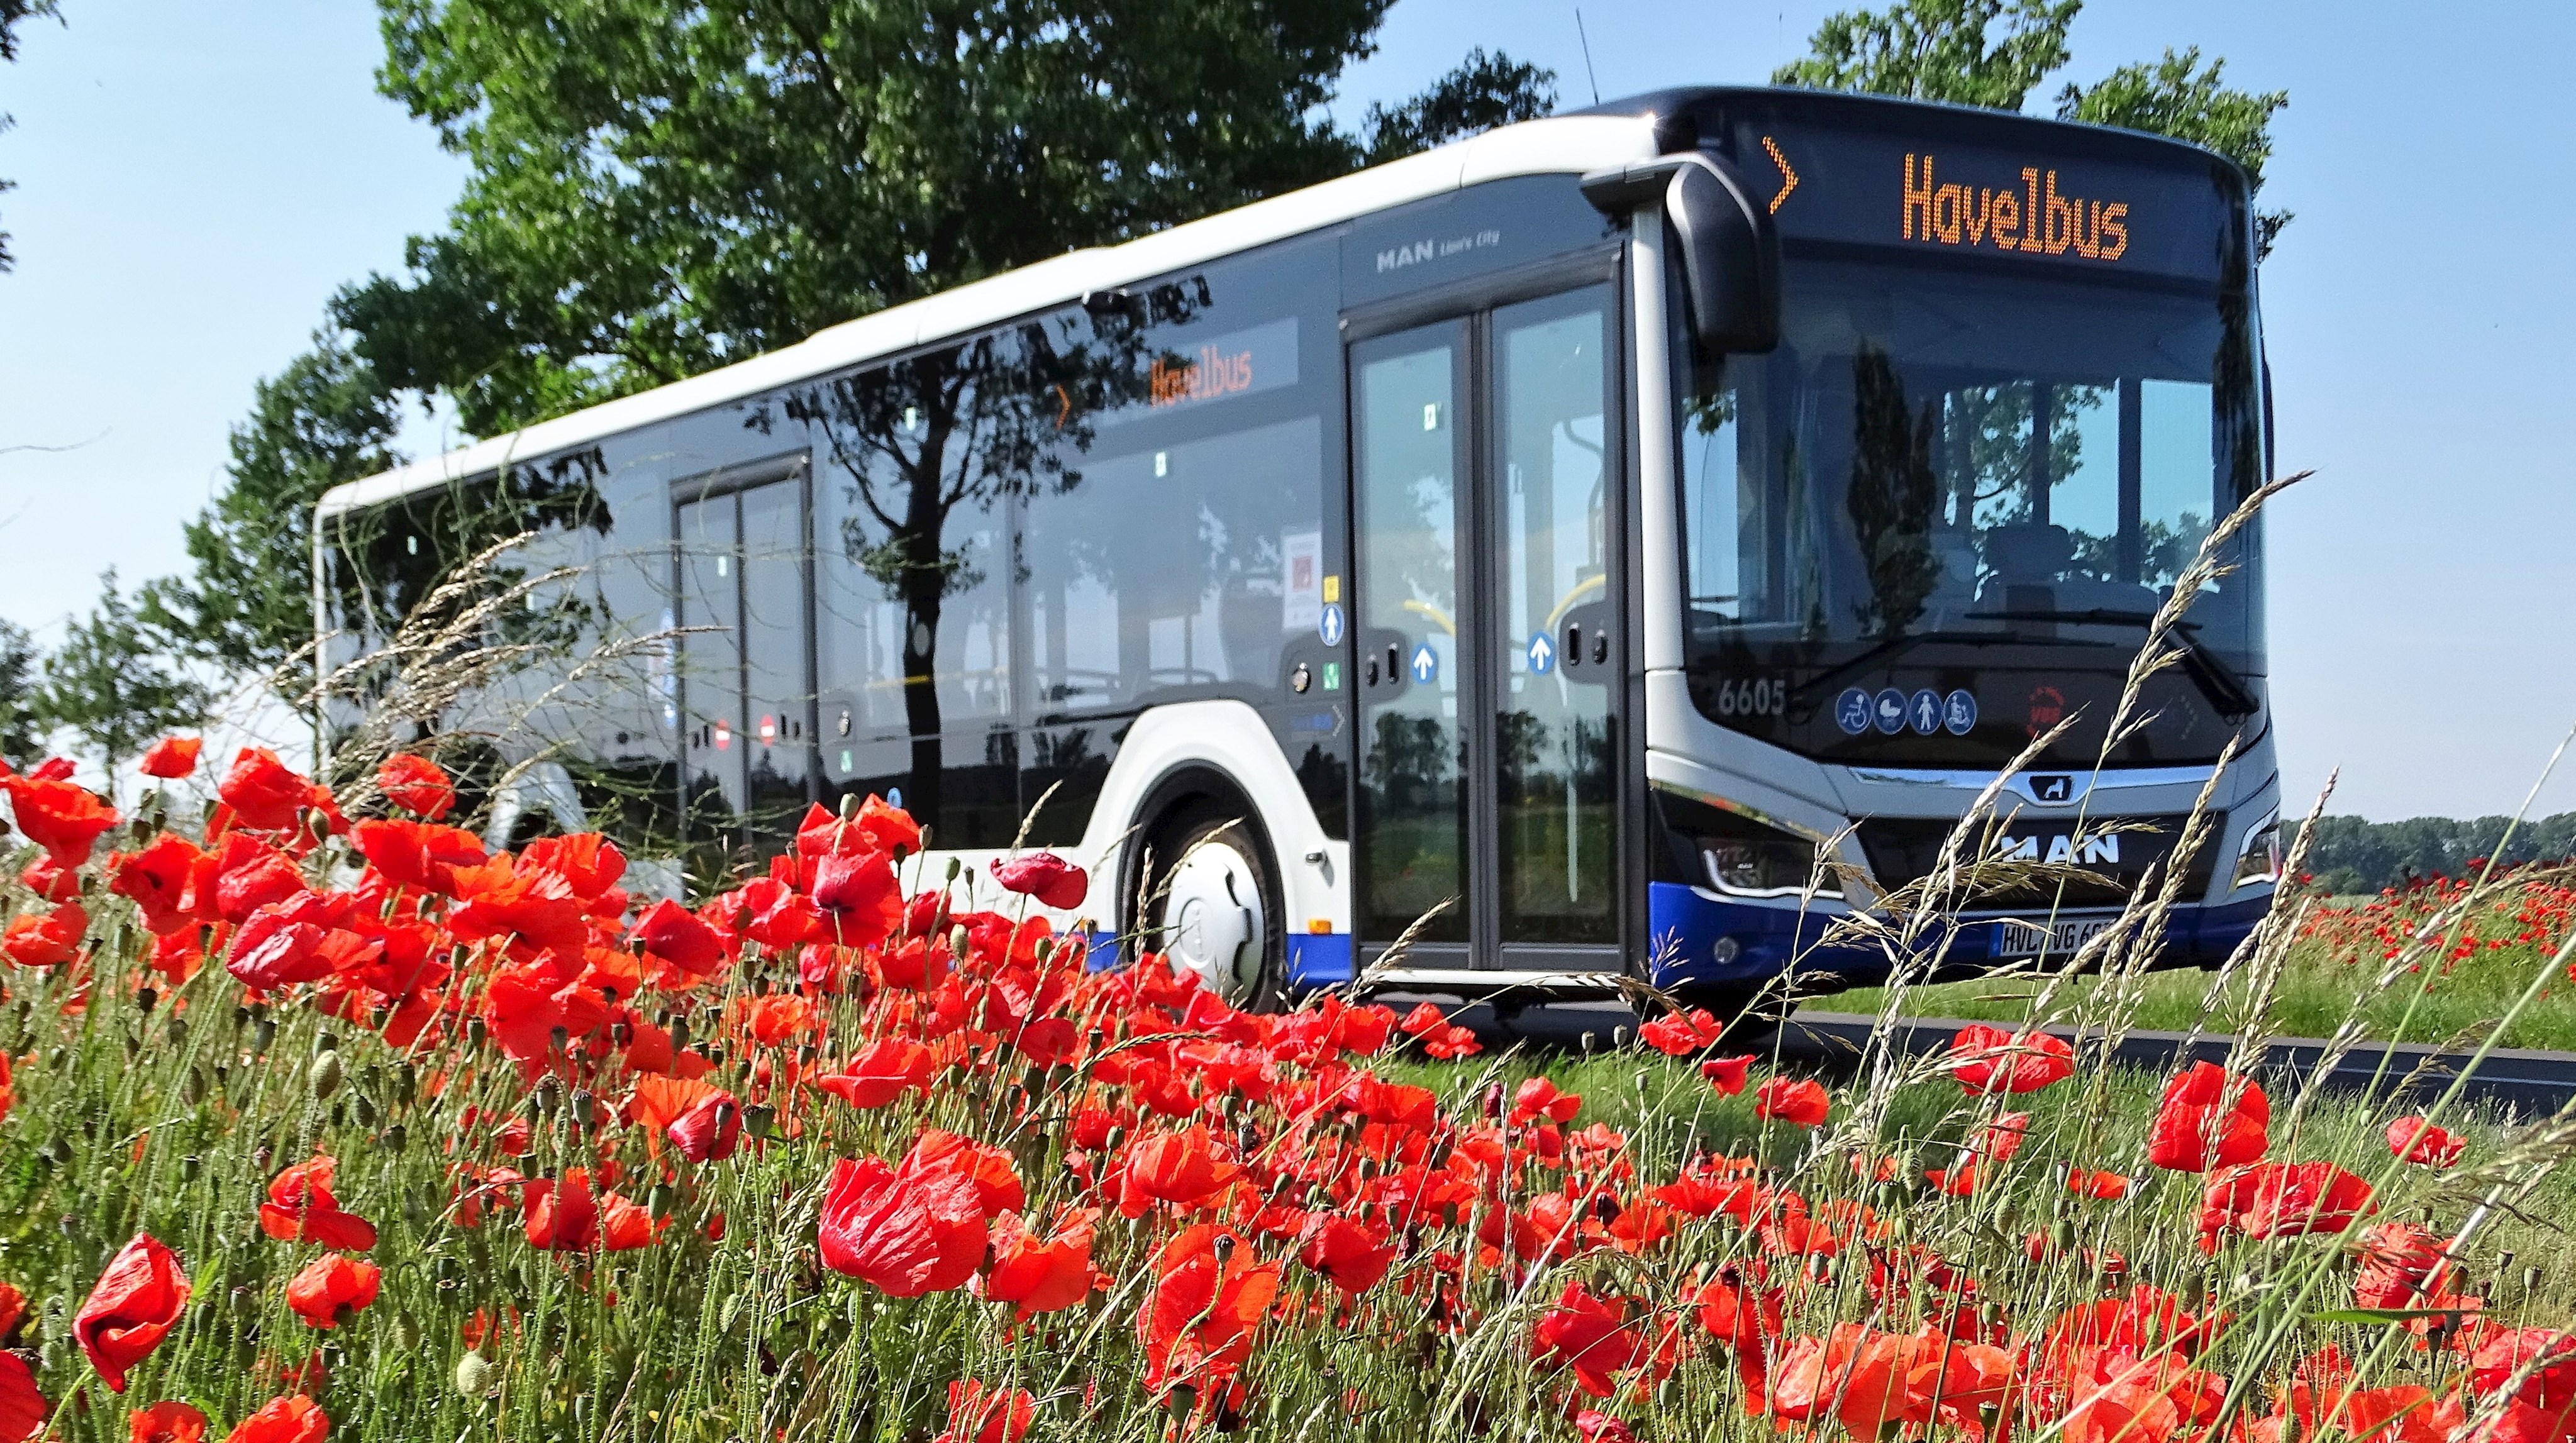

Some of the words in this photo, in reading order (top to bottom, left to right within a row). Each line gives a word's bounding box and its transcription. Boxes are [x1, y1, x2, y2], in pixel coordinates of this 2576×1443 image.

[1903, 153, 2128, 260] Havelbus
[1377, 238, 1433, 272] MAN
[1150, 345, 1252, 409] Havelbus
[1719, 678, 1785, 715] 6605
[2001, 834, 2119, 864] MAN
[2003, 924, 2037, 951] HVL
[2053, 924, 2075, 950] VG
